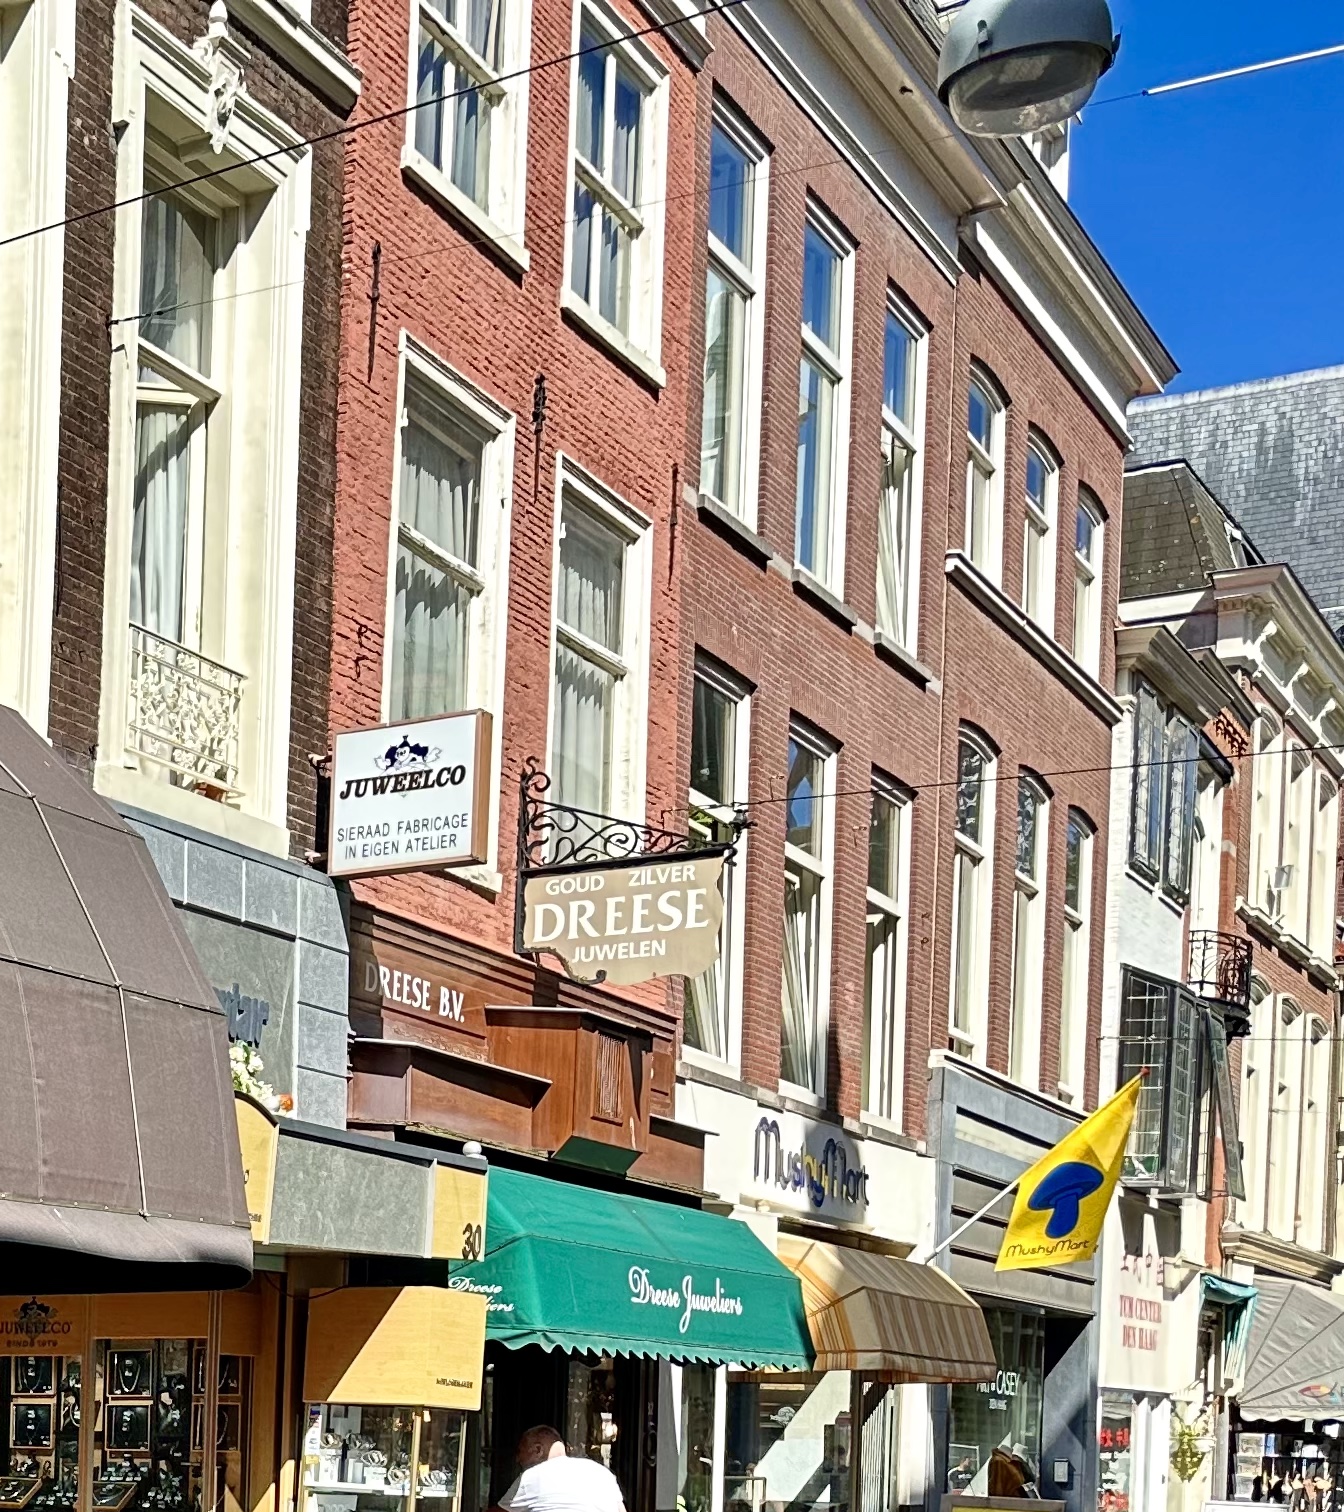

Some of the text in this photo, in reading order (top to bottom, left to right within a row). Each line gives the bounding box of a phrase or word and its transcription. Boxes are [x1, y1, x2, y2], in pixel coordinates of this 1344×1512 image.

[339, 764, 466, 801] JUWEELCO
[337, 812, 469, 843] SIERAAD FABRICAGE
[344, 834, 458, 860] IN EIGEN ATELIER
[545, 864, 696, 896] GOUD ZILVER
[533, 888, 710, 943] DREESE
[571, 938, 667, 964] JUWELEN
[365, 961, 465, 1024] DREESE B.V.
[462, 1222, 482, 1260] 30
[1005, 1240, 1089, 1258] MushyMart
[448, 1276, 503, 1293] Dreese
[628, 1265, 743, 1333] Dreese Juweliers
